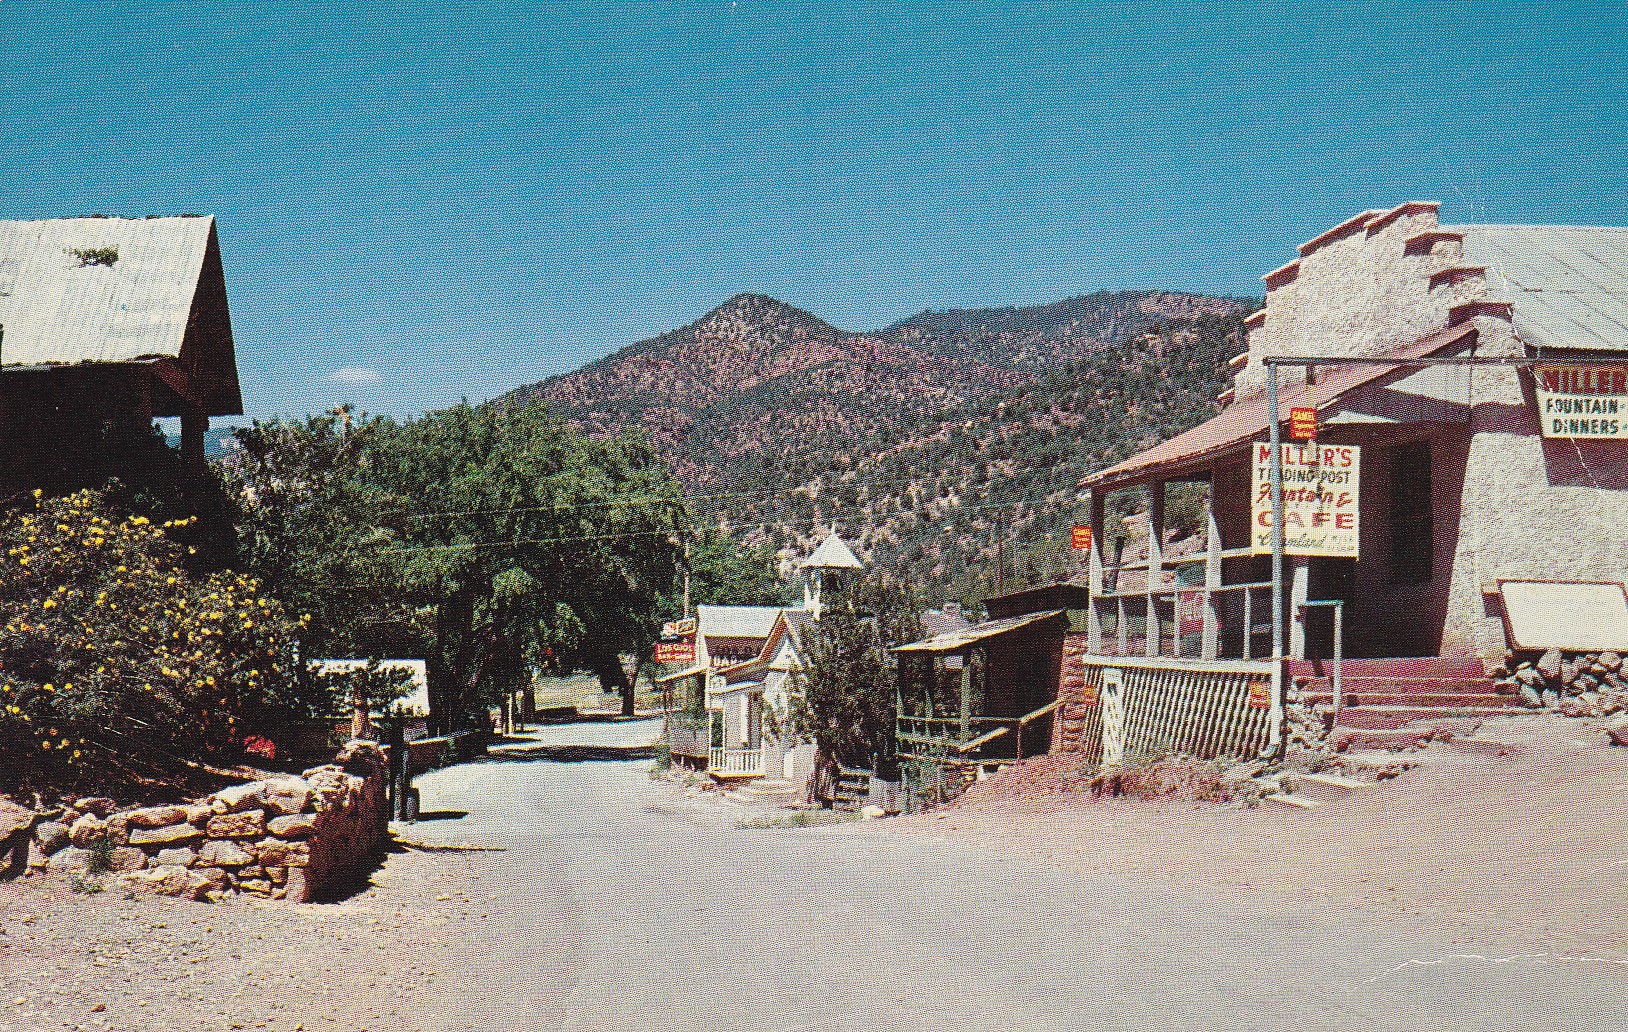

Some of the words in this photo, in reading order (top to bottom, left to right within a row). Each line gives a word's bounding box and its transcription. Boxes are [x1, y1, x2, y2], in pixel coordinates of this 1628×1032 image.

[1545, 398, 1619, 415] FOUNTAIN
[1551, 418, 1620, 435] DINNERS
[1259, 445, 1352, 467] MLLR'S
[1258, 467, 1316, 482] TDING
[1321, 470, 1352, 484] POST
[1257, 510, 1354, 529] CAFE
